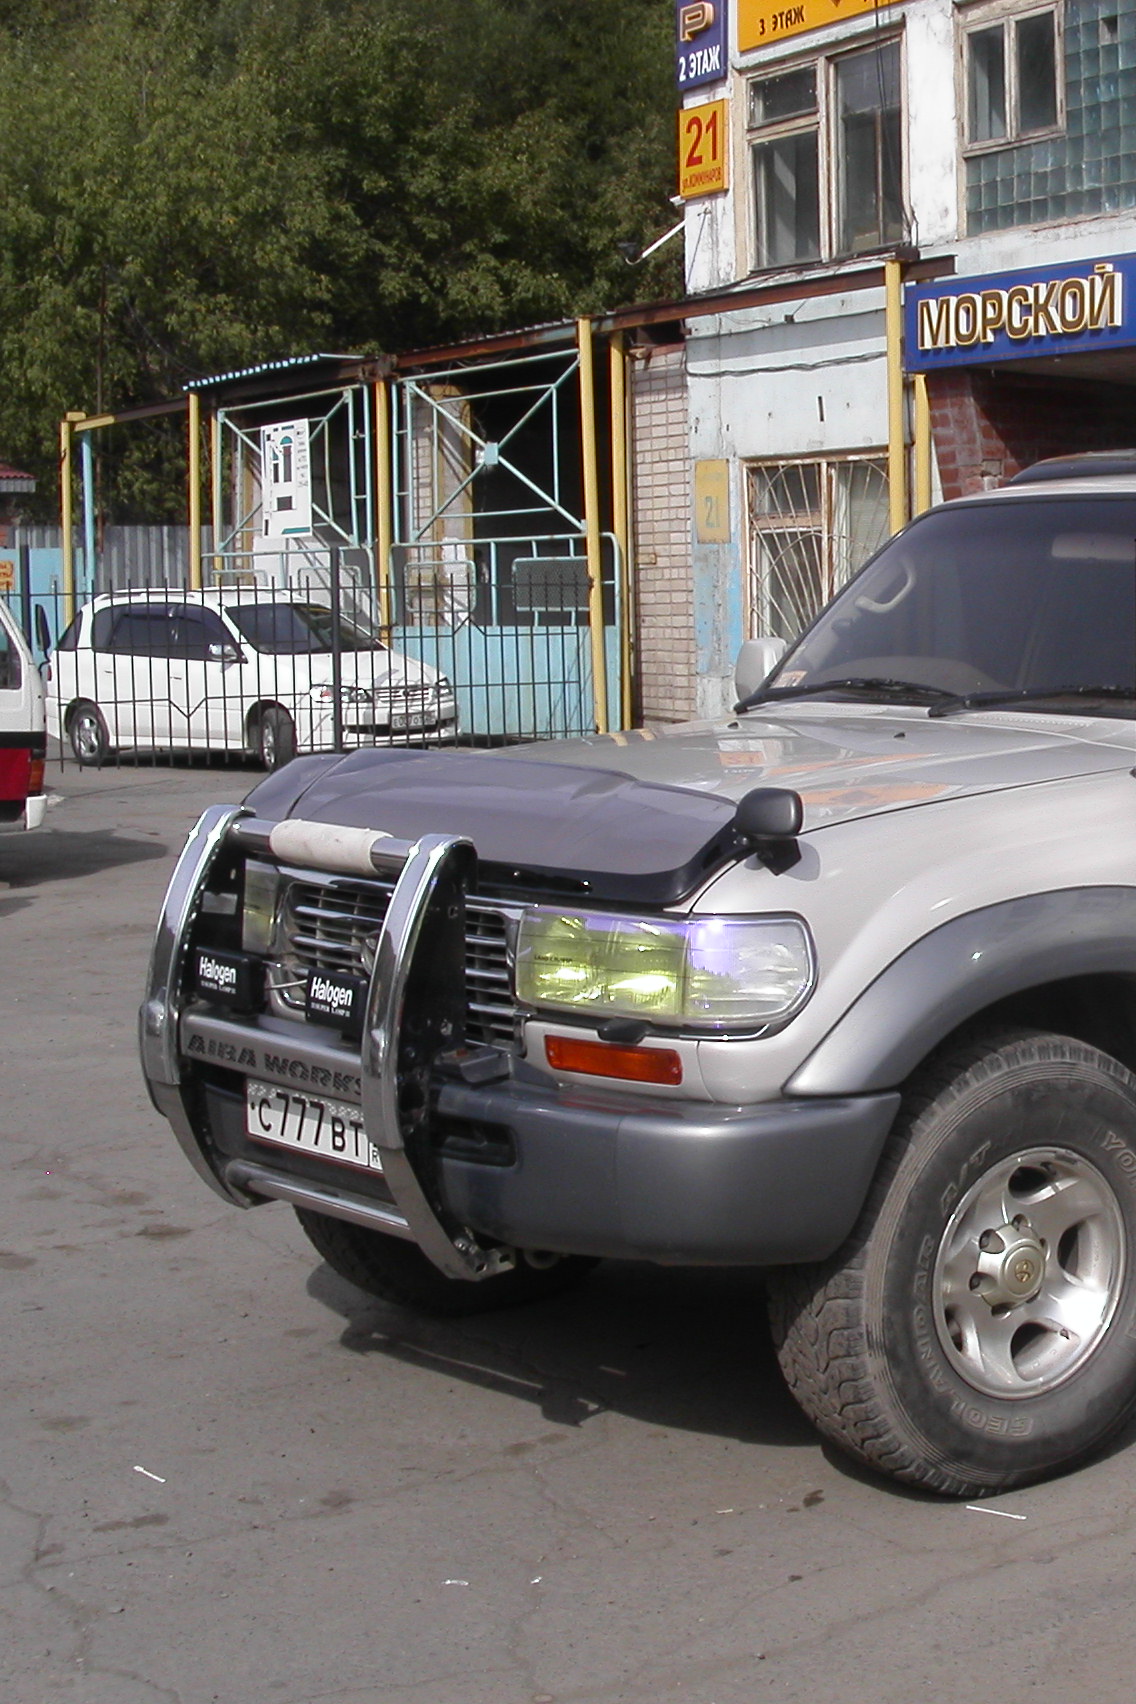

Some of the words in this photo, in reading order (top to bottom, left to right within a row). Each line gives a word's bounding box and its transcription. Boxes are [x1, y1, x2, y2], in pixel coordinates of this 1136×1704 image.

[759, 19, 766, 36] 3
[772, 6, 805, 31] ЭТАЖ
[678, 57, 688, 83] 2
[688, 45, 720, 79] ЭТАЖ
[685, 111, 717, 168] 21
[917, 263, 1122, 351] МОРСКОЙ
[199, 955, 237, 986] Halogen
[311, 976, 354, 1009] Halogen
